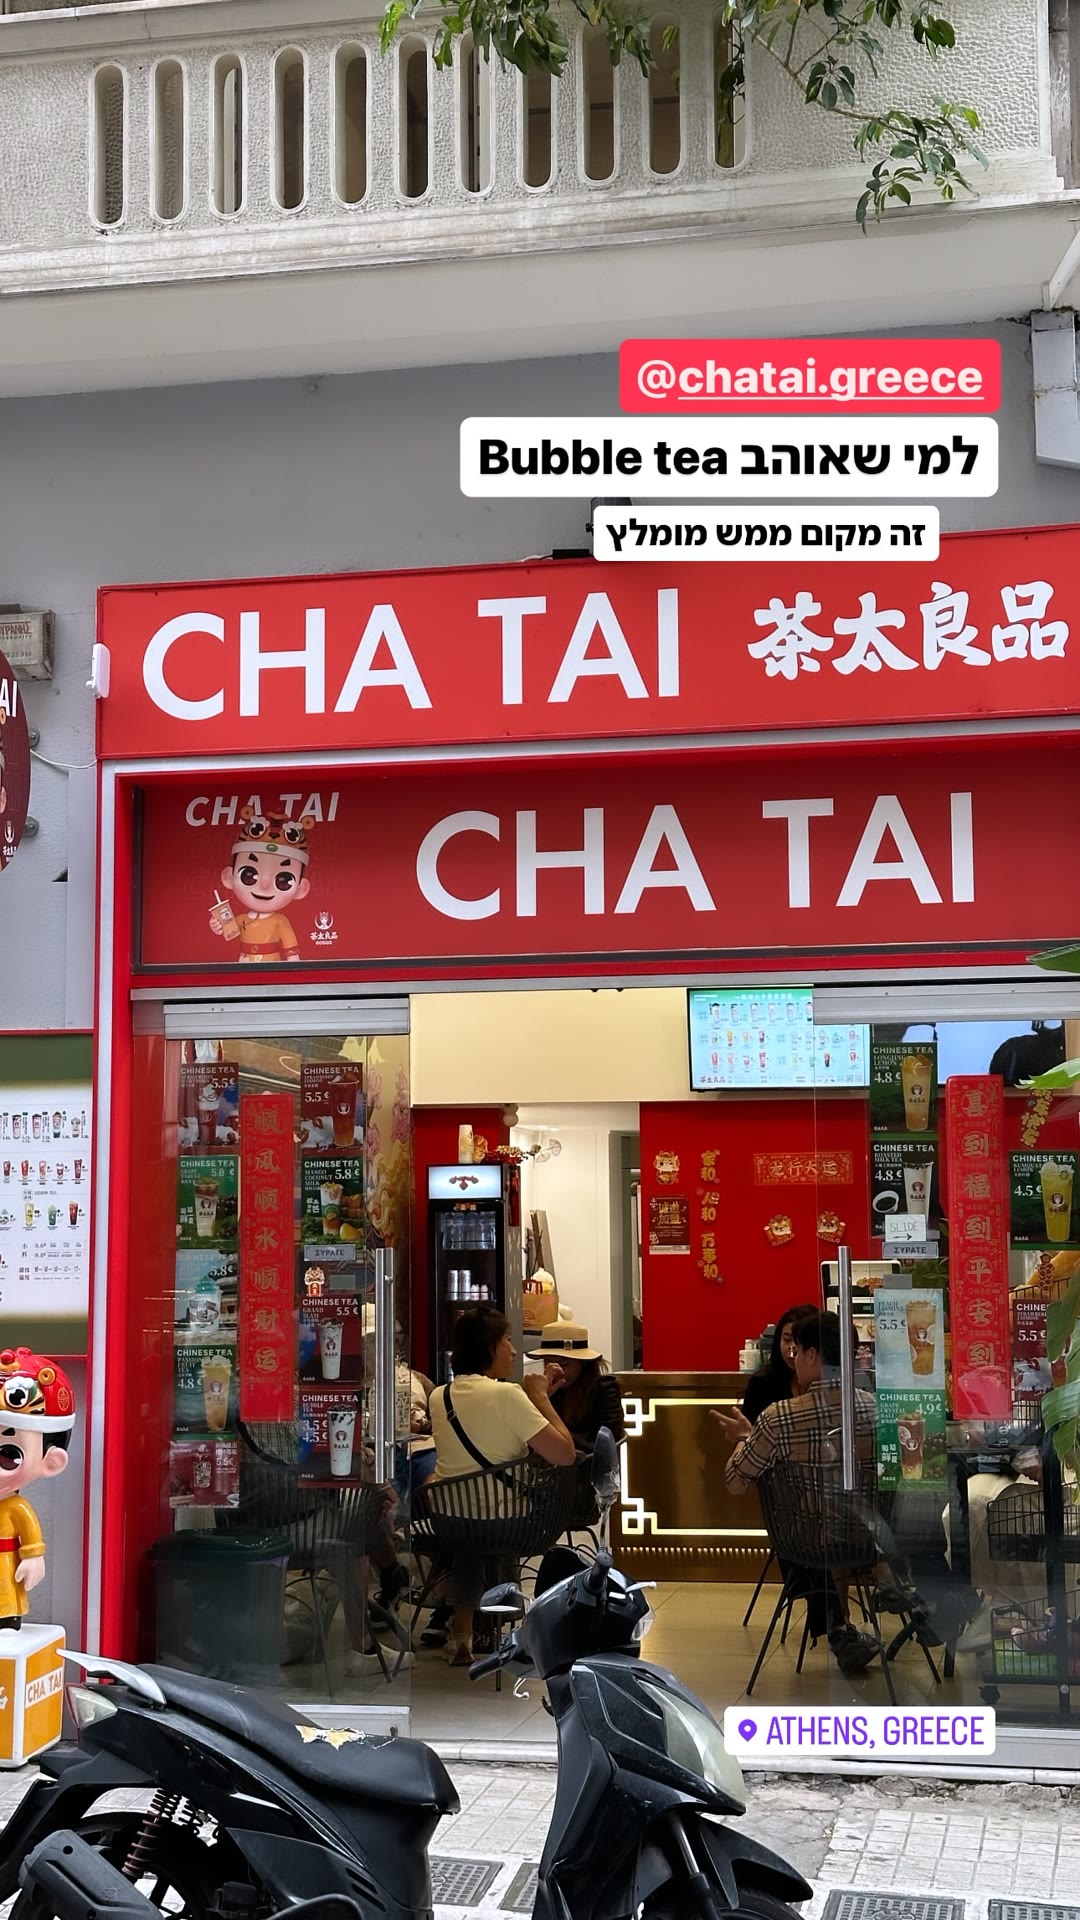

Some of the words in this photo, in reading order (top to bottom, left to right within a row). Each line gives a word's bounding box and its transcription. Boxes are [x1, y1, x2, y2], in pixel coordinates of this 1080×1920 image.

[747, 581, 1069, 681] 茶太良品
[143, 604, 432, 720] CHA
[478, 589, 680, 704] TAI
[185, 795, 263, 826] CHA
[279, 792, 339, 822] TAI
[416, 804, 717, 921] CHA
[763, 791, 975, 908] TAI
[915, 1046, 934, 1054] TEA
[873, 1144, 914, 1152] CHINESE
[916, 1144, 935, 1152] TEA
[1056, 1155, 1076, 1163] TEA
[180, 1160, 216, 1168] CHINESE
[889, 1222, 919, 1233] SLIDE
[894, 1246, 927, 1254] ΣΥΡΑΤΕ
[303, 1298, 339, 1306] CHINESE
[302, 1394, 339, 1402] CHINESE
[341, 1394, 359, 1402] TEA
[880, 1393, 921, 1401] CHINESE
[28, 1680, 46, 1702] CHA
[48, 1671, 62, 1692] TAI
